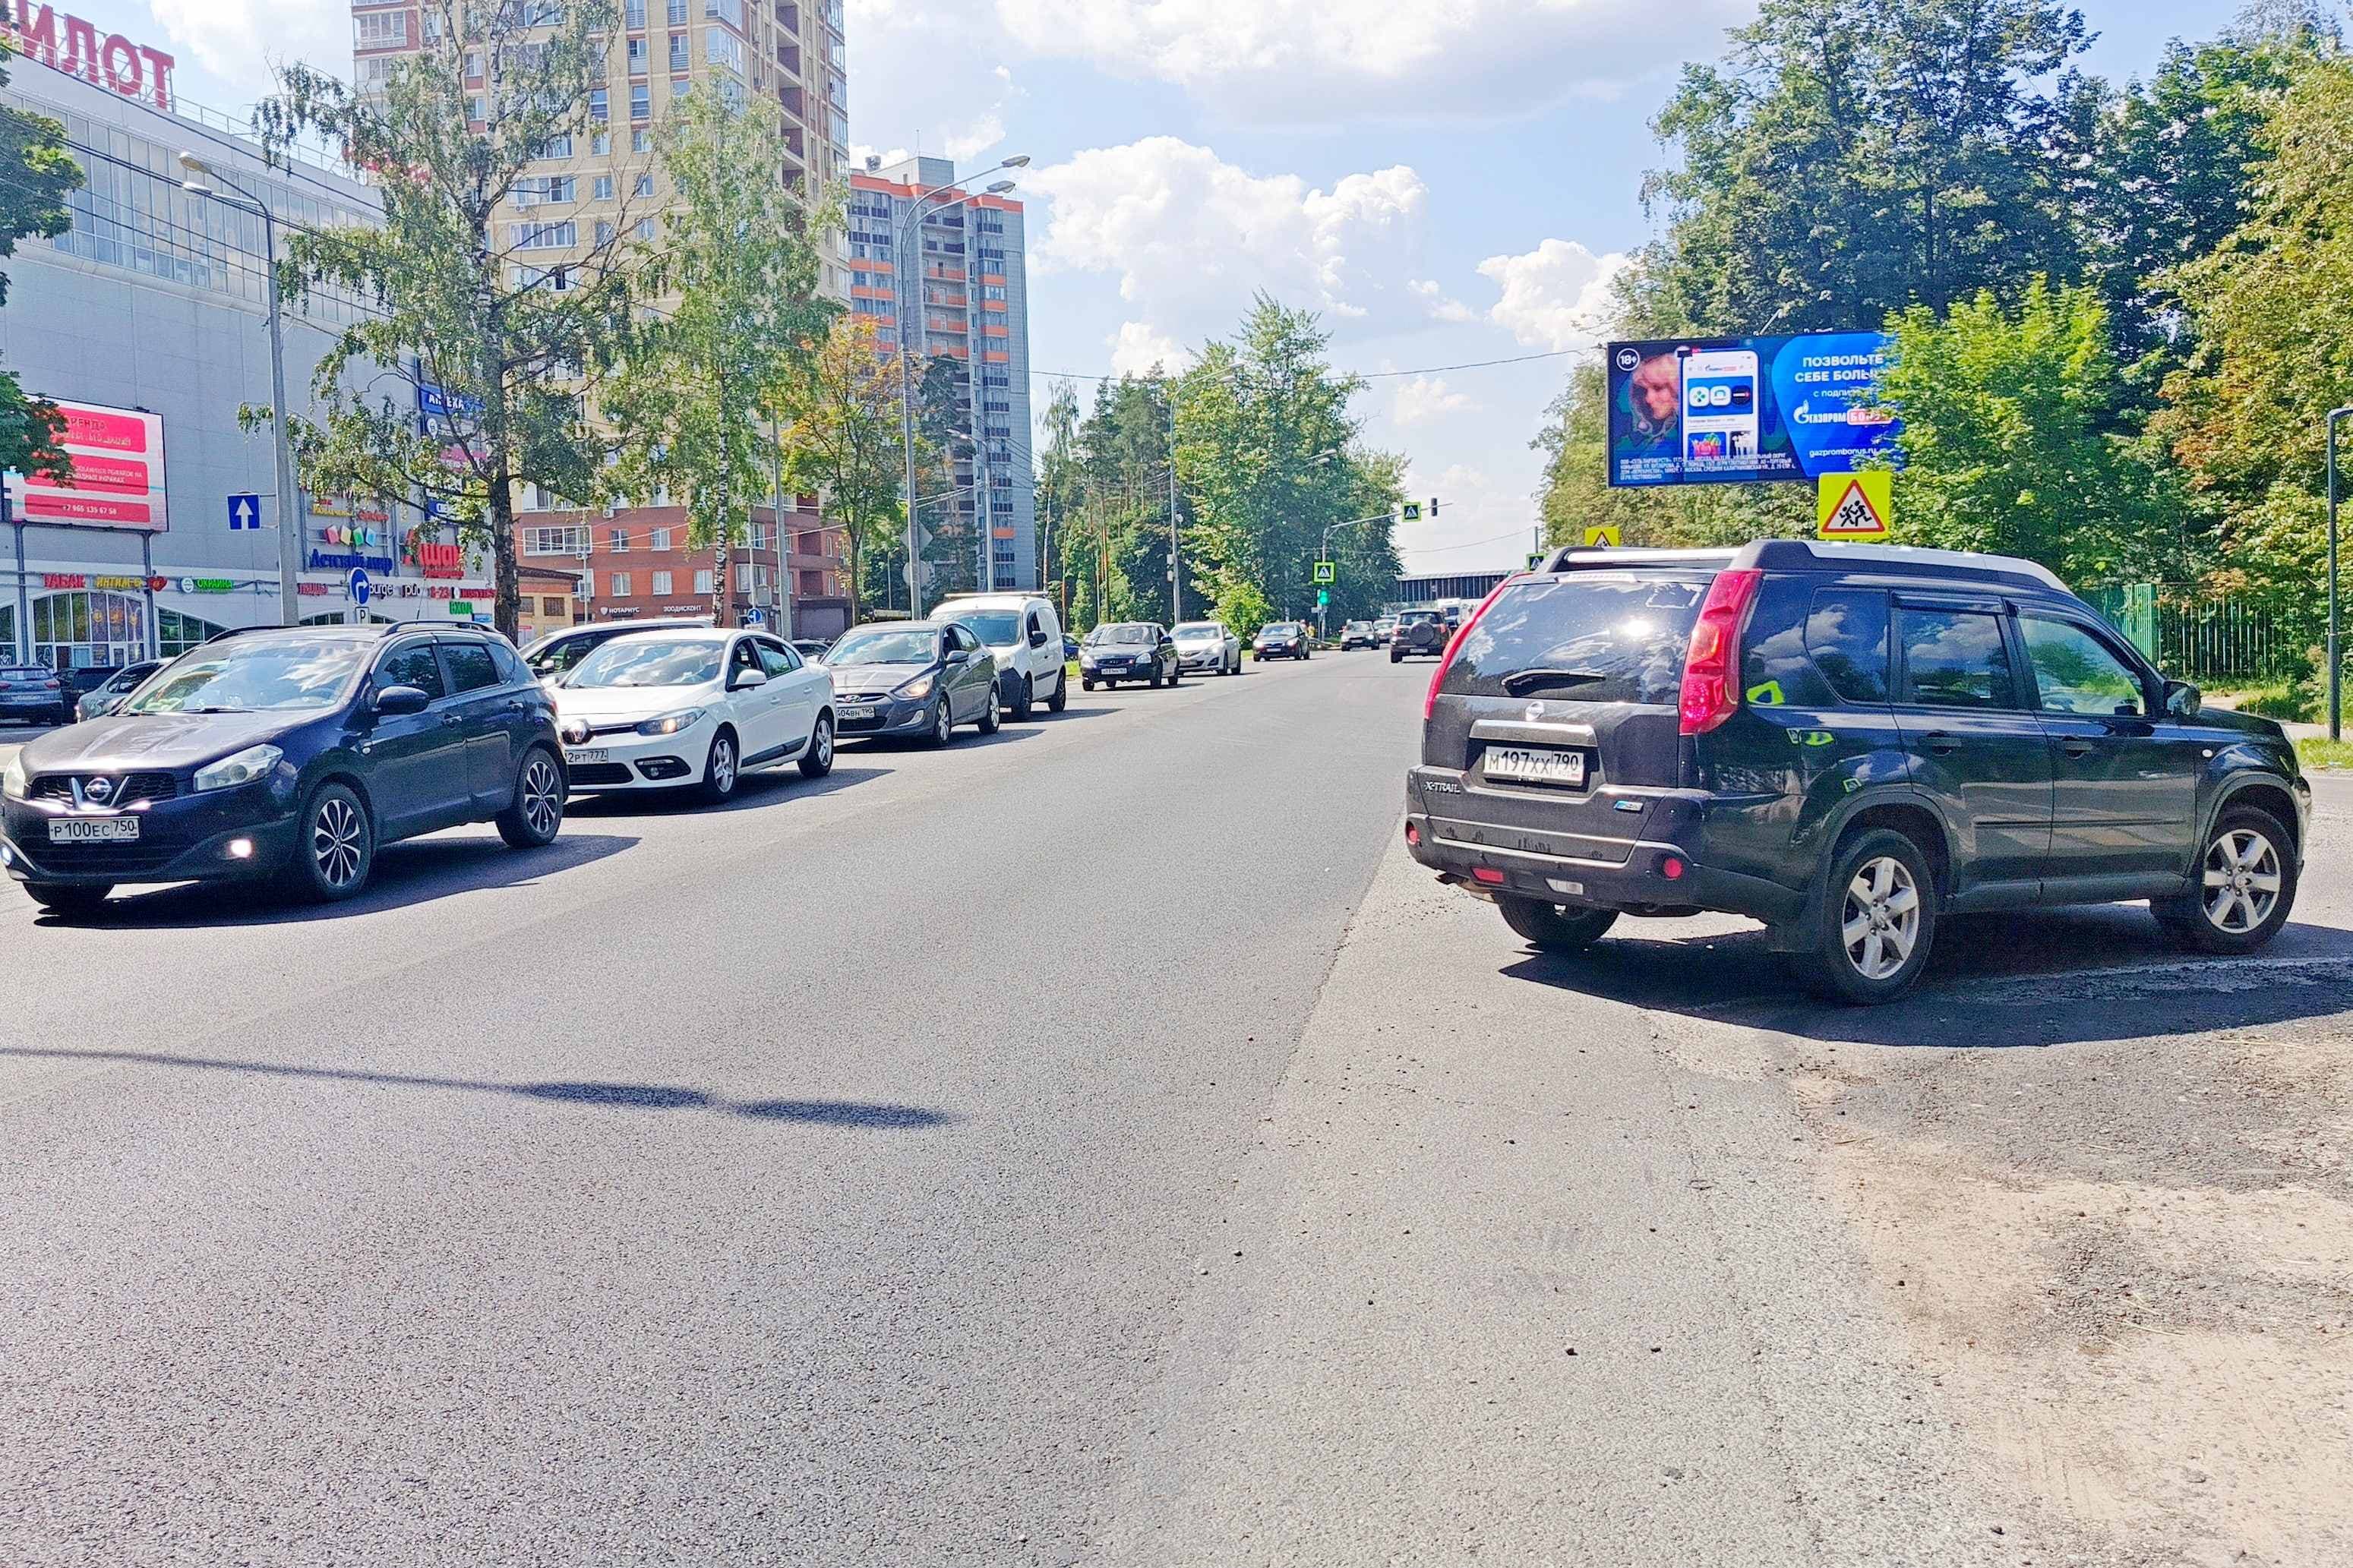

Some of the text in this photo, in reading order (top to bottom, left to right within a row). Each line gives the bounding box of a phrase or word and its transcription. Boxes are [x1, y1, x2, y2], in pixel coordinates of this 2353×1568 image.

[1620, 355, 1638, 365] 18+
[1802, 354, 1884, 368] ПОЗВОЛЬТЕ
[1795, 369, 1879, 382] СЕБЕ БОЛЬ
[428, 393, 465, 410] АПЕКА
[69, 417, 105, 431] РЕНДА
[1809, 447, 1877, 458] gazprombonus.ru
[450, 601, 472, 614] ВХОД
[565, 752, 587, 762] 2РТ
[1423, 781, 1461, 793] X-TRAIL
